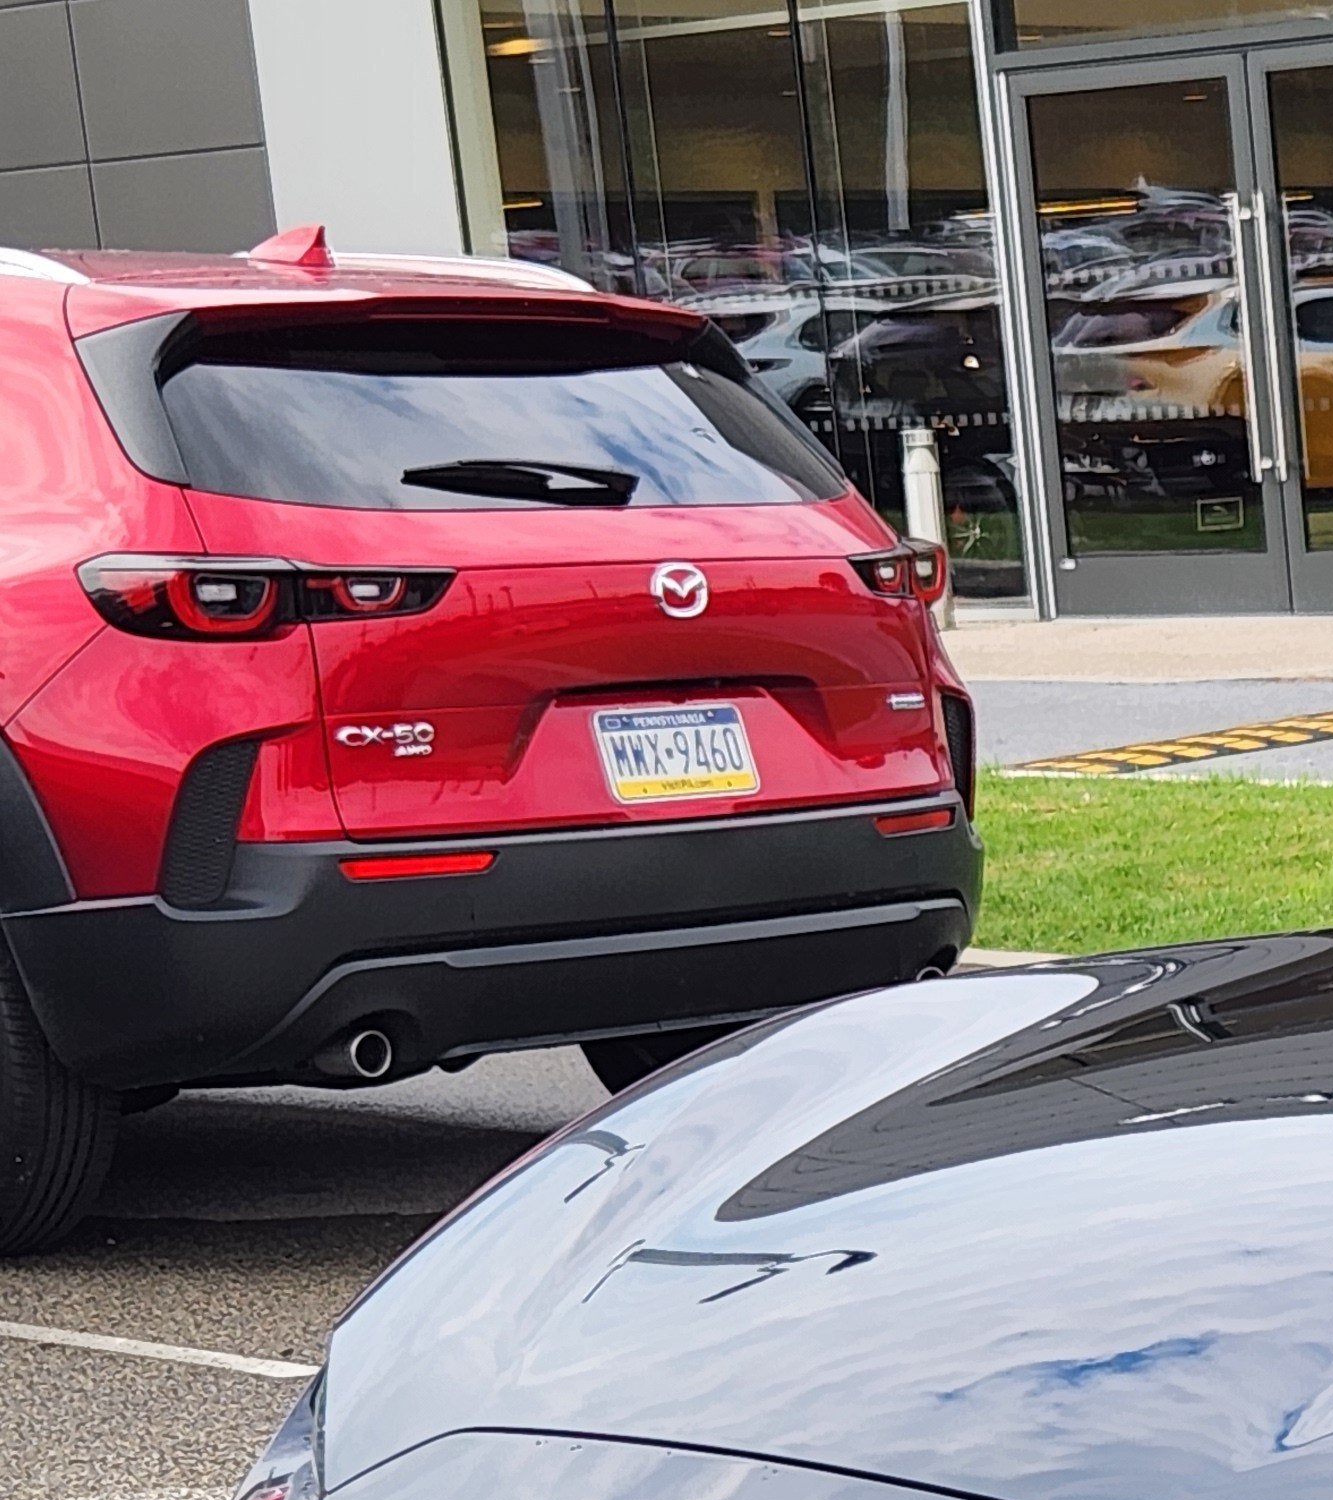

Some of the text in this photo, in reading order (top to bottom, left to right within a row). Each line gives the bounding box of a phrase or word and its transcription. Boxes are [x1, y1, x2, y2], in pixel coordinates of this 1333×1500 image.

[633, 712, 706, 728] PENNSYLVANIA
[335, 721, 435, 747] CX-50
[394, 744, 433, 757] AWD
